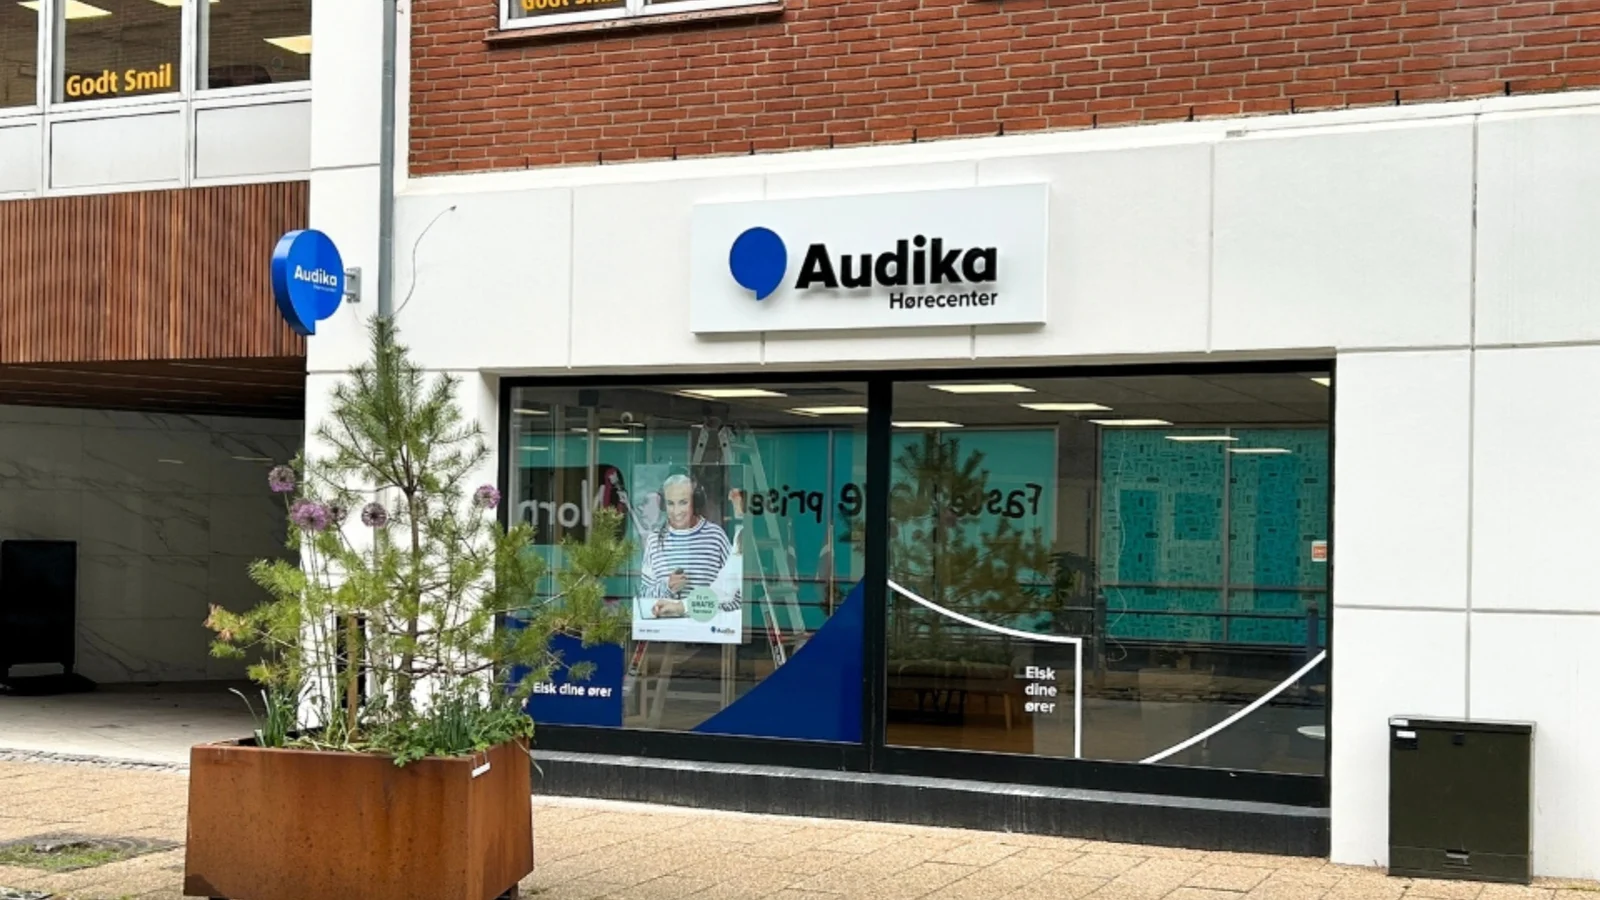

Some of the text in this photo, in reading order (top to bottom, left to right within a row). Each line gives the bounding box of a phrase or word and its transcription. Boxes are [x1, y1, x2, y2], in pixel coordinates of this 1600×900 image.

[66, 63, 172, 97] Godt Smil
[794, 234, 998, 289] Audika
[294, 264, 338, 287] Audika
[889, 291, 998, 309] Hørecenter
[1026, 666, 1056, 680] Elsk
[533, 682, 613, 697] Elsk dine ører
[1025, 683, 1057, 697] dine
[1025, 701, 1055, 713] ører
